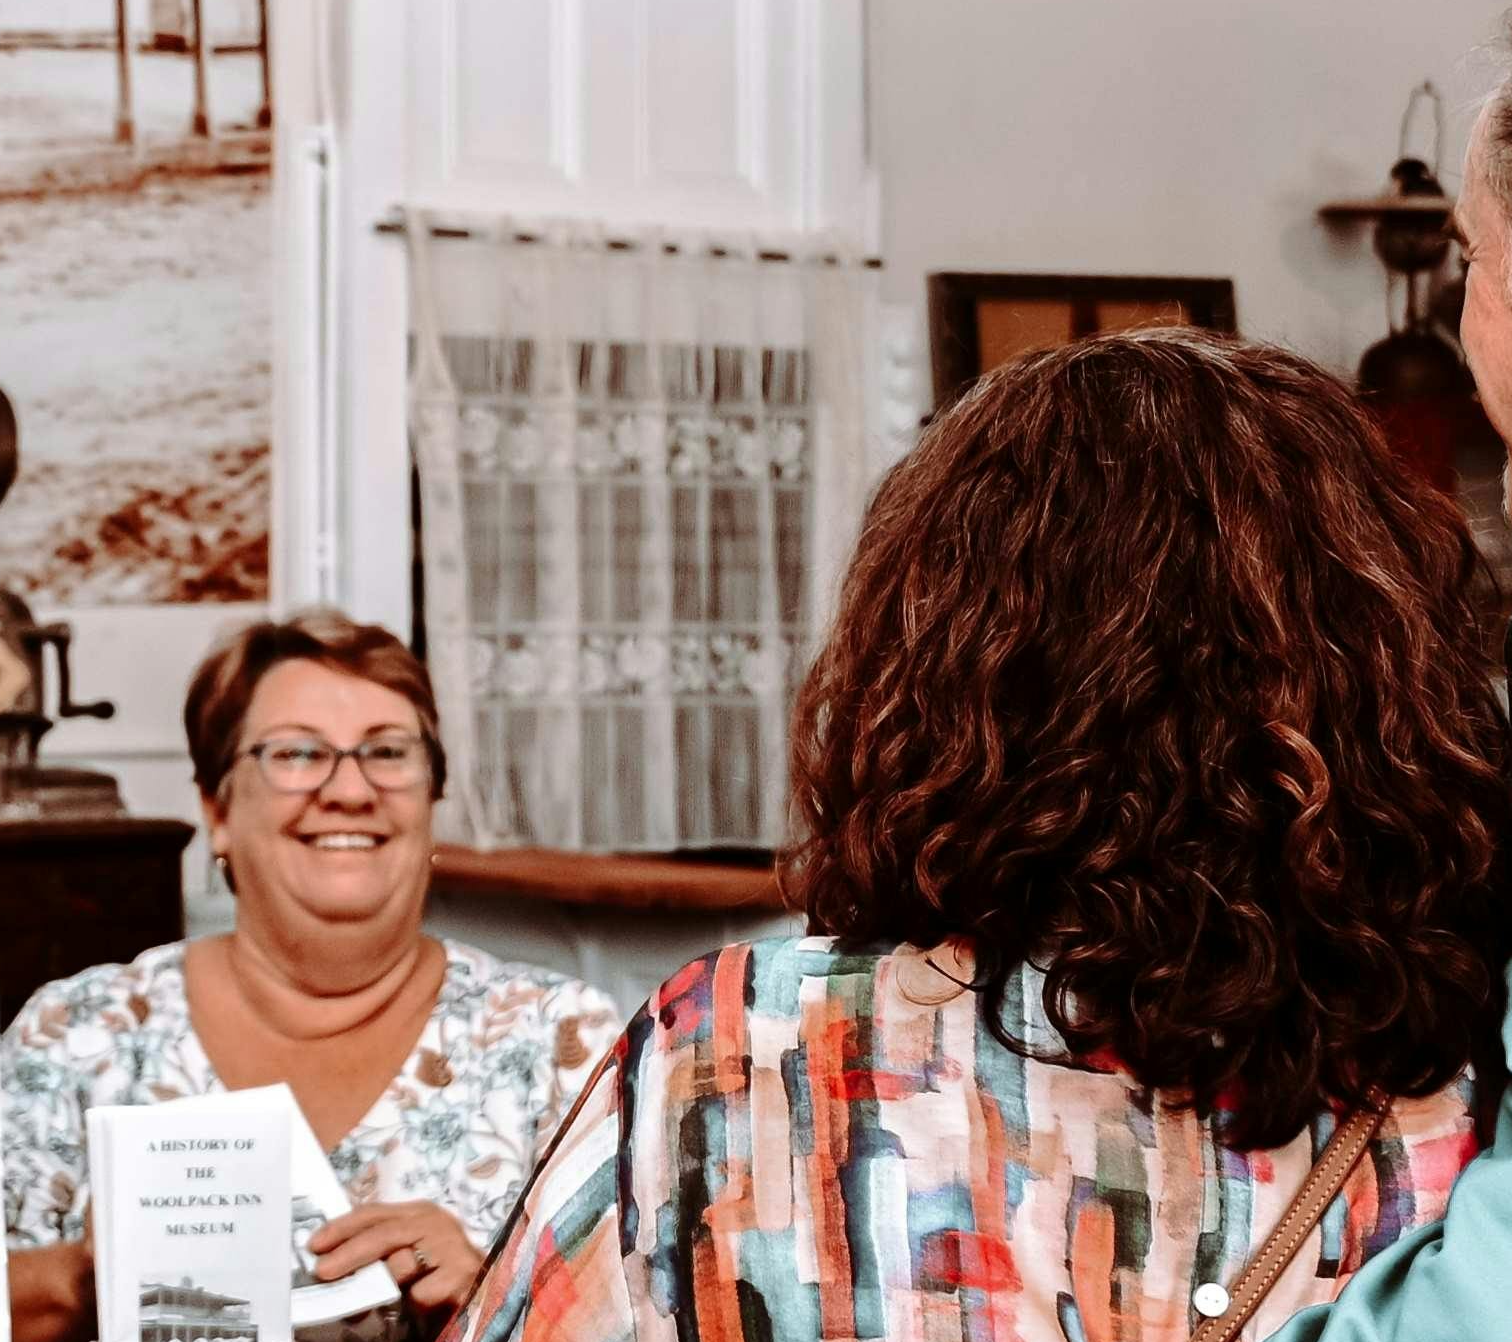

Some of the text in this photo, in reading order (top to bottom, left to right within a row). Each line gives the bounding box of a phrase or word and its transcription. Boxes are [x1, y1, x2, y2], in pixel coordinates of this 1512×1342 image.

[146, 1138, 255, 1153] A HISTORY OF
[185, 1166, 216, 1179] THE
[139, 1193, 263, 1208] WOOLPACK INN
[165, 1221, 235, 1236] MUSEUM
